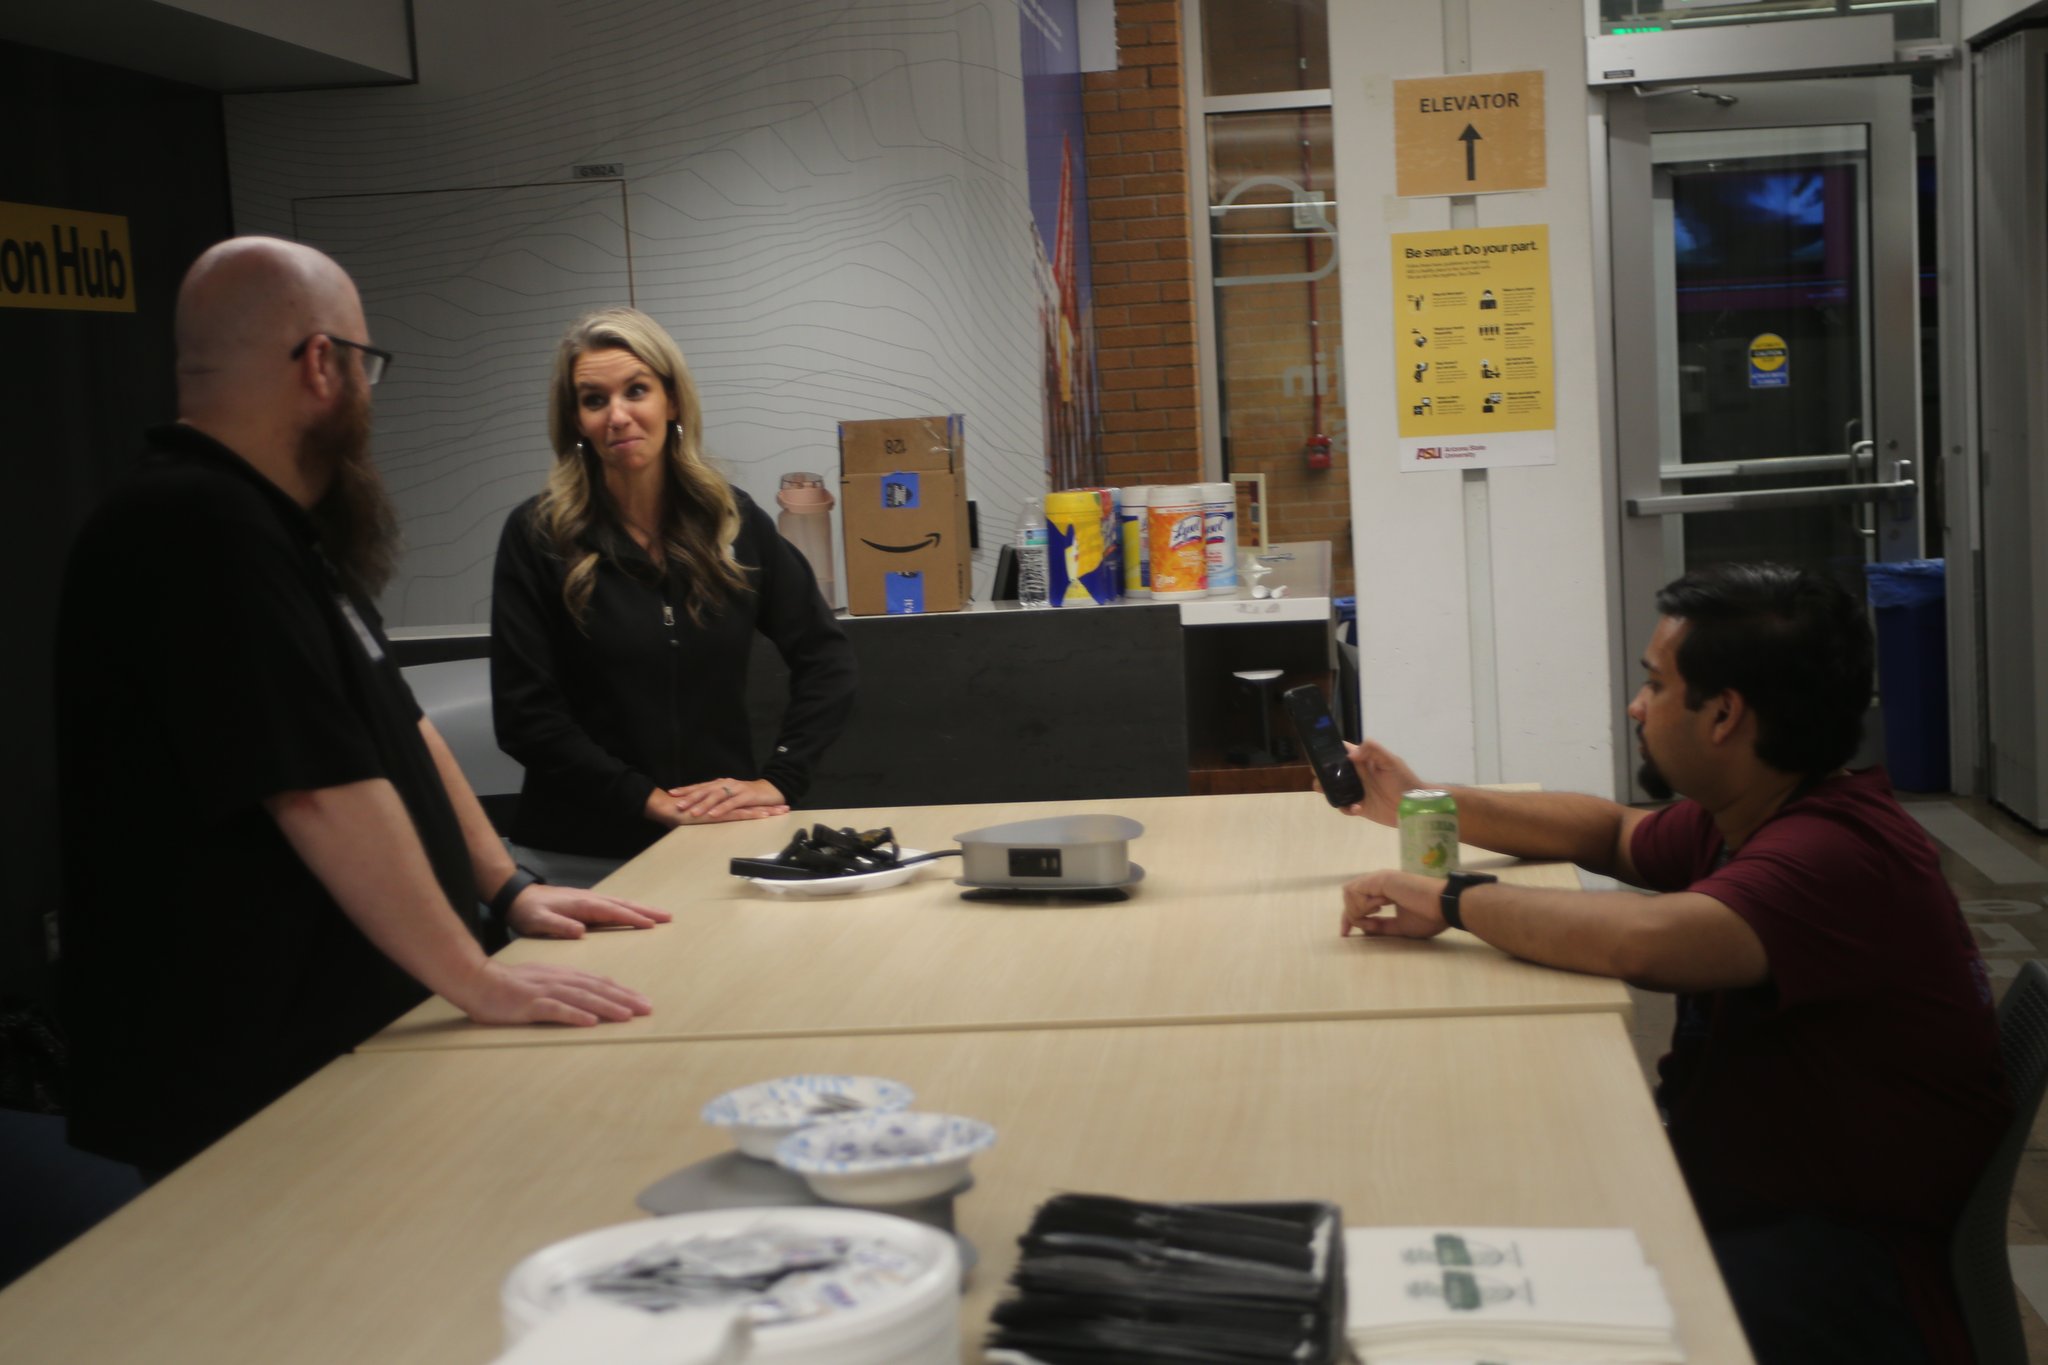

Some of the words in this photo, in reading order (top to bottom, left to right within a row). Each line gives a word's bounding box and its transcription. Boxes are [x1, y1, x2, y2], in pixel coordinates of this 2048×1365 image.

[1420, 92, 1520, 113] ELEVATOR
[1406, 248, 1421, 258] Be
[1424, 246, 1461, 258] smart.
[1463, 244, 1480, 255] Do
[1482, 243, 1508, 256] your
[1511, 241, 1539, 253] part.
[0, 238, 51, 294] on
[52, 224, 127, 299] Hub
[1416, 447, 1442, 460] ASU
[1174, 518, 1202, 541] Lysol
